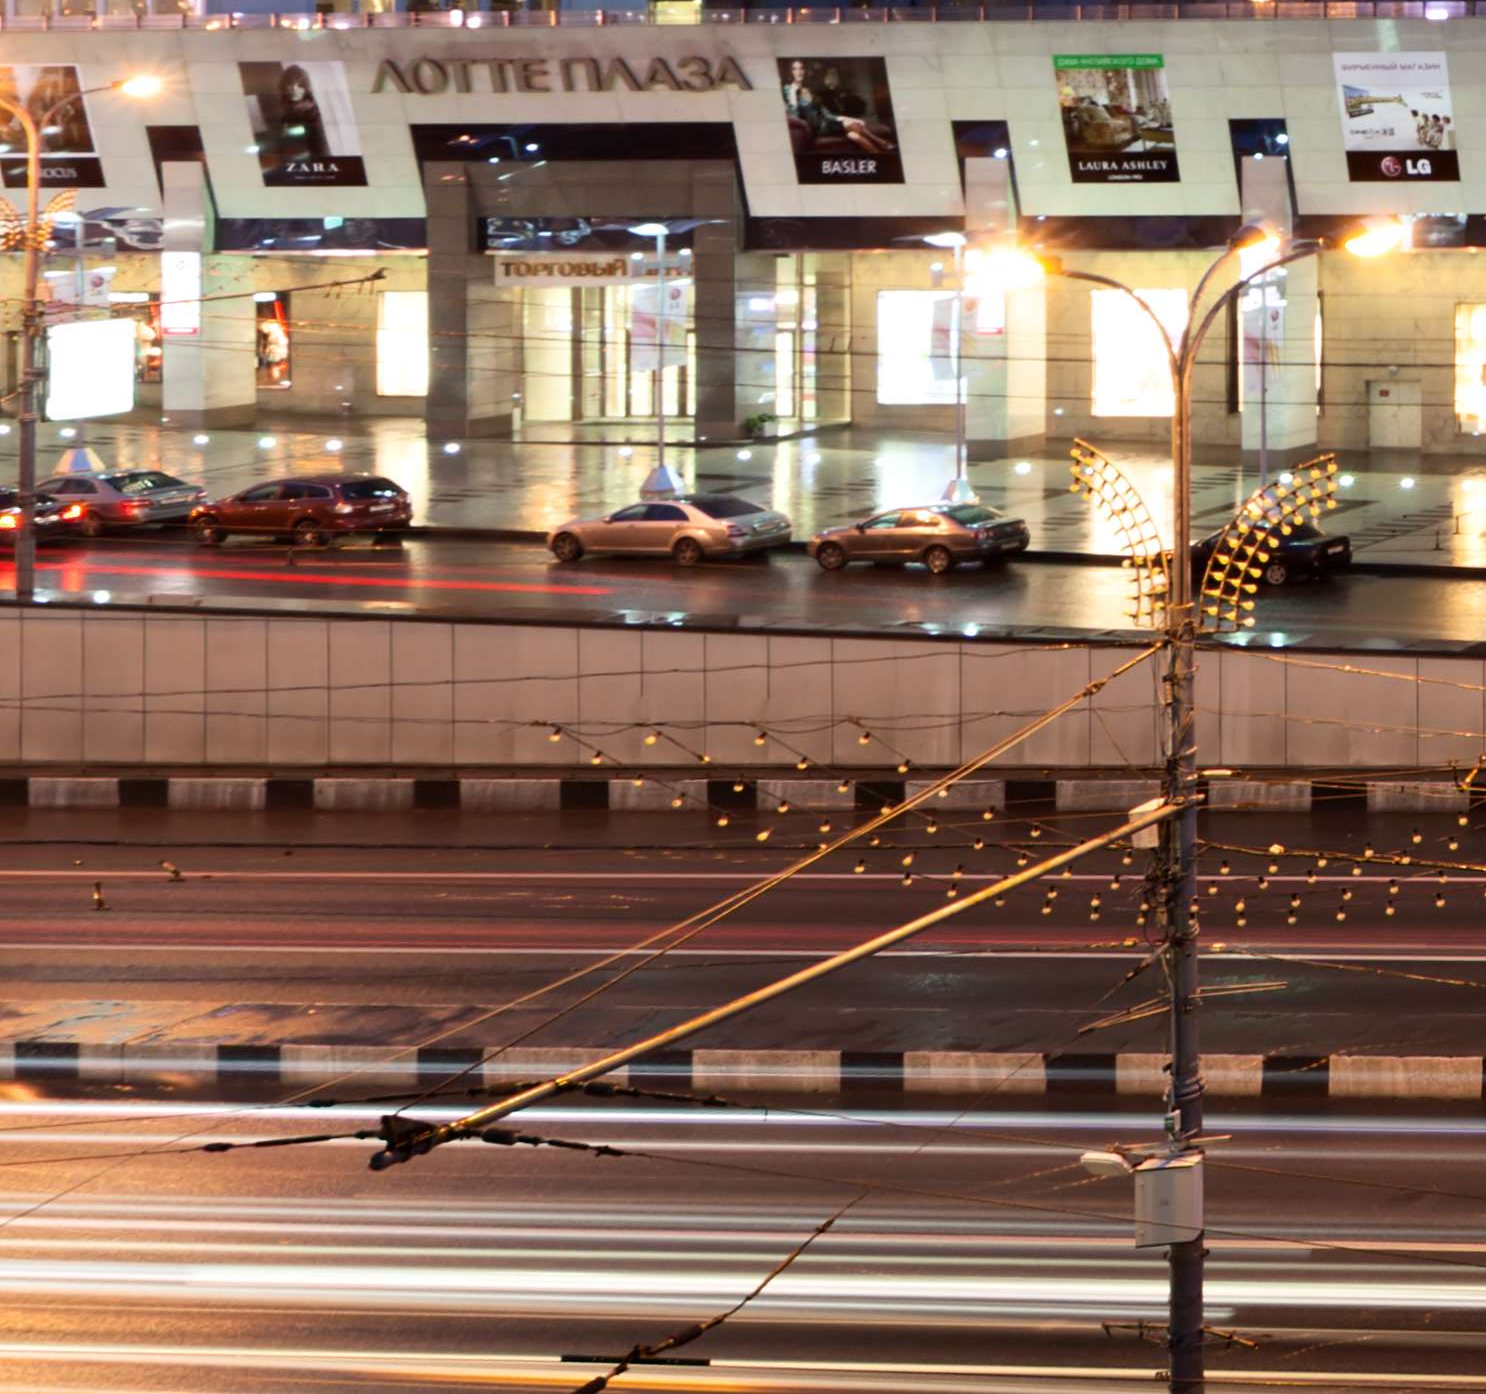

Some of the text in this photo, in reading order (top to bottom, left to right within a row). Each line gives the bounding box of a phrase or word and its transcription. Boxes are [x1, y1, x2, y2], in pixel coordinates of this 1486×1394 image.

[371, 55, 753, 95] ЛОТТЕ ПЛАЗА
[286, 163, 339, 172] ZARA
[822, 160, 877, 174] BASLER
[1078, 160, 1168, 171] LAURA ASHLEY
[1406, 159, 1432, 175] LG
[502, 258, 627, 277] ТОРГОВЫЙ
